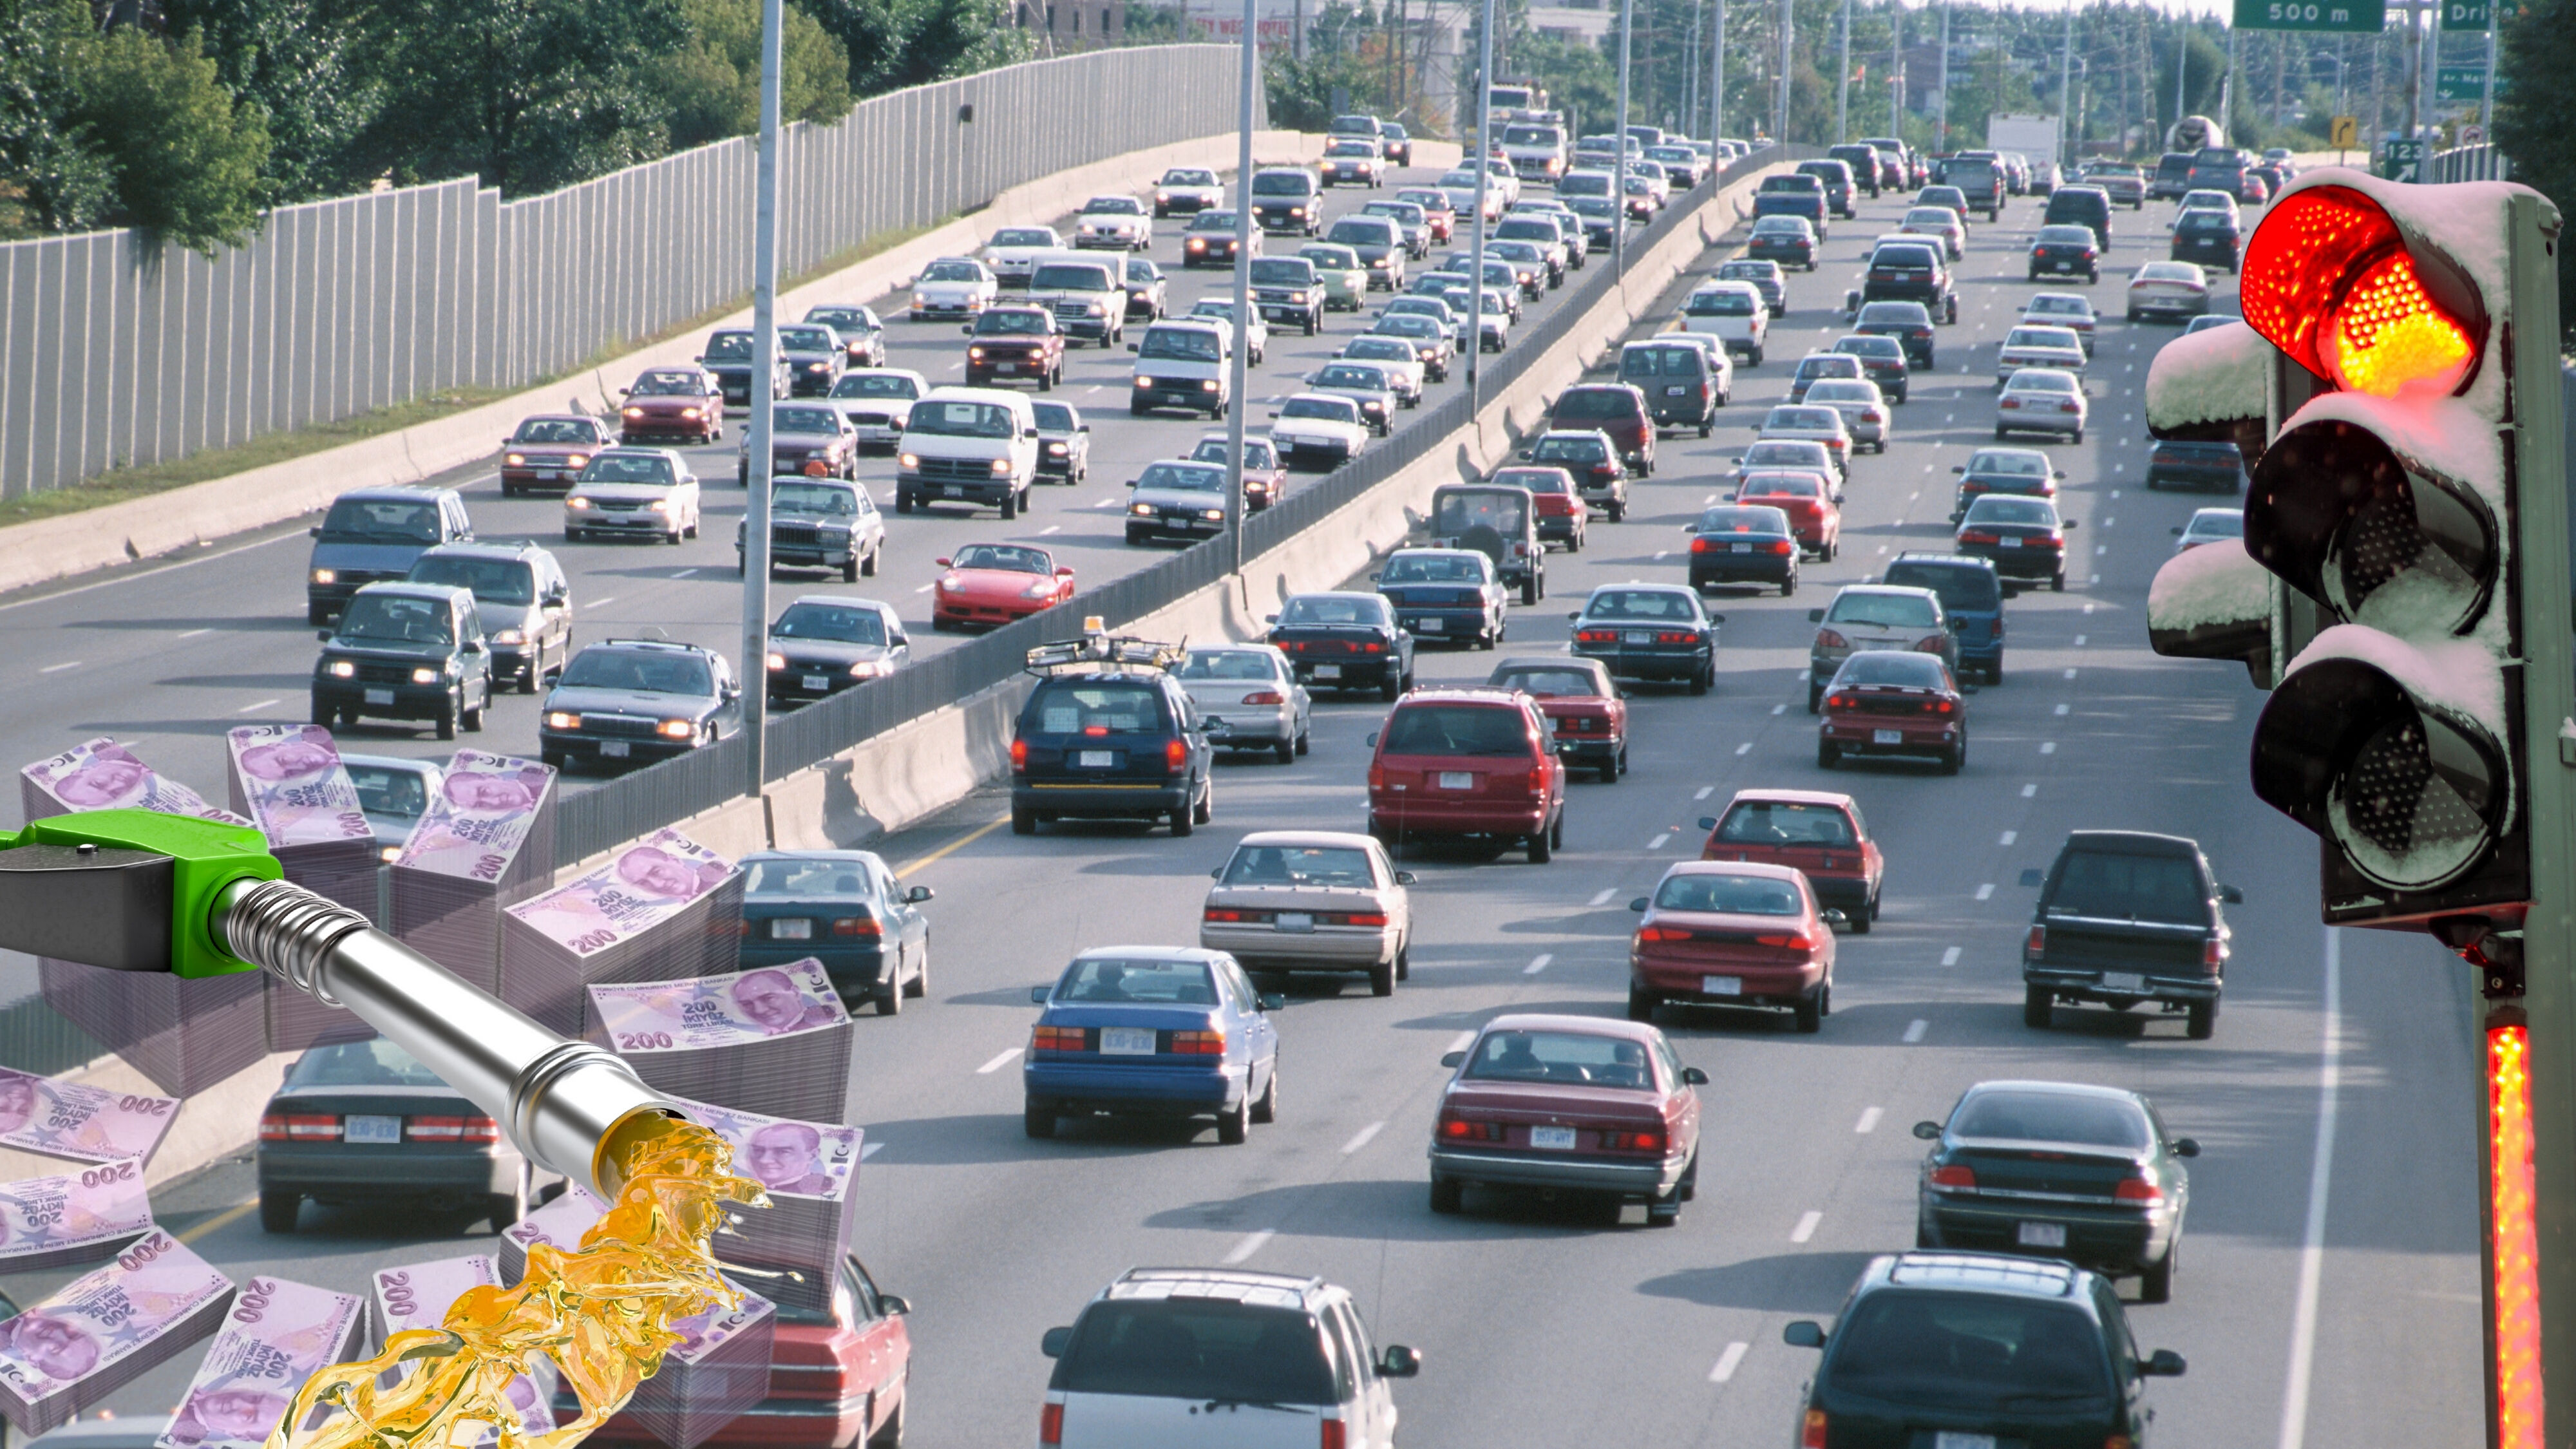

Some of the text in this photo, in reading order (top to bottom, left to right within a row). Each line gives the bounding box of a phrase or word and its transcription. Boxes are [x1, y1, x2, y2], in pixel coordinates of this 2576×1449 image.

[2269, 3, 2349, 21] 500 m
[2452, 4, 2514, 21] Drie
[2389, 144, 2423, 159] 123
[337, 812, 371, 837] 200
[469, 855, 507, 880] 200
[591, 890, 623, 908] 200
[568, 929, 618, 954] 200
[681, 1001, 716, 1014] 200
[618, 1032, 673, 1050] 200
[119, 1095, 173, 1116] 200
[48, 1116, 82, 1131] 200
[82, 1162, 136, 1189] 200
[28, 1212, 63, 1227] 200
[511, 1223, 566, 1252] 20
[118, 1233, 172, 1272] 200
[234, 1278, 276, 1323] 200
[379, 1271, 418, 1316] 200
[101, 1303, 138, 1327] 200
[265, 1351, 292, 1379] 200
